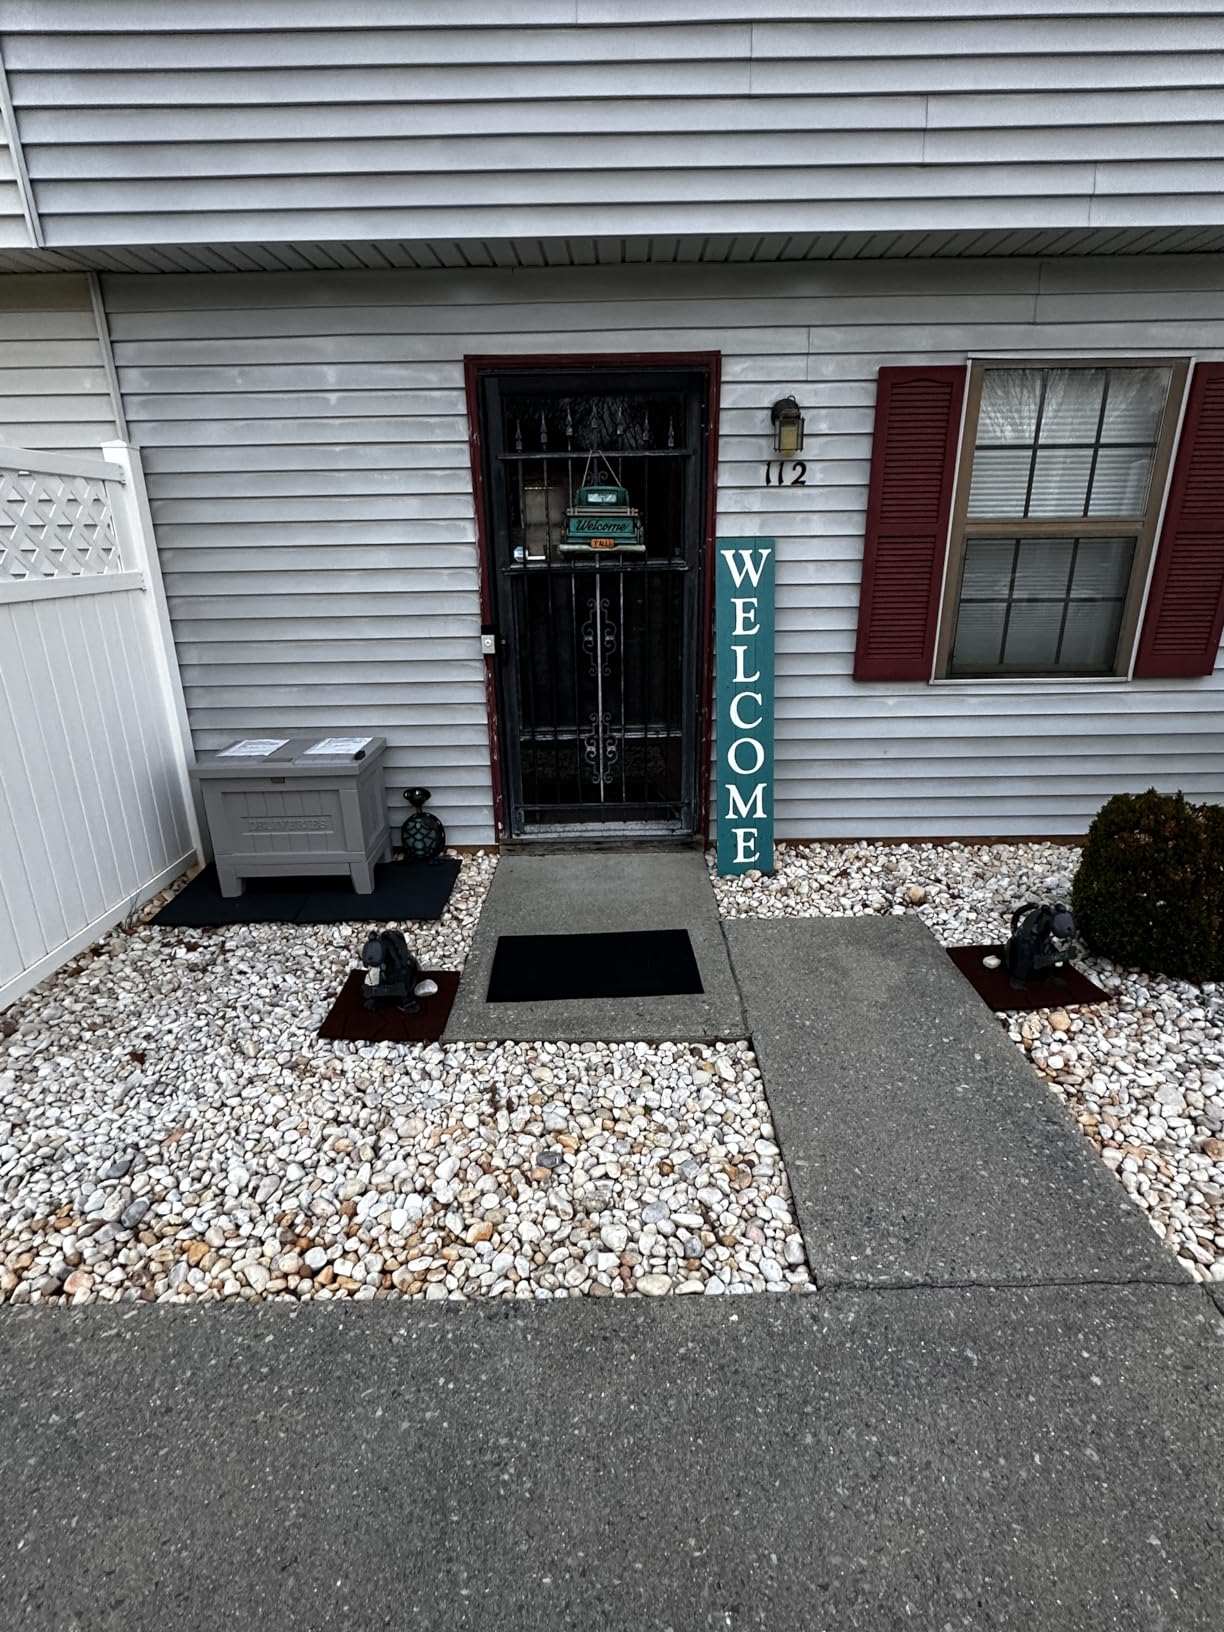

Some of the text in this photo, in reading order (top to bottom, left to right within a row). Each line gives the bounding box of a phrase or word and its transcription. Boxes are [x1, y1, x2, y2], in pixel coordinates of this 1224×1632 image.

[765, 461, 807, 486] 112
[576, 519, 629, 532] Welcome
[720, 548, 772, 864] WELCOME
